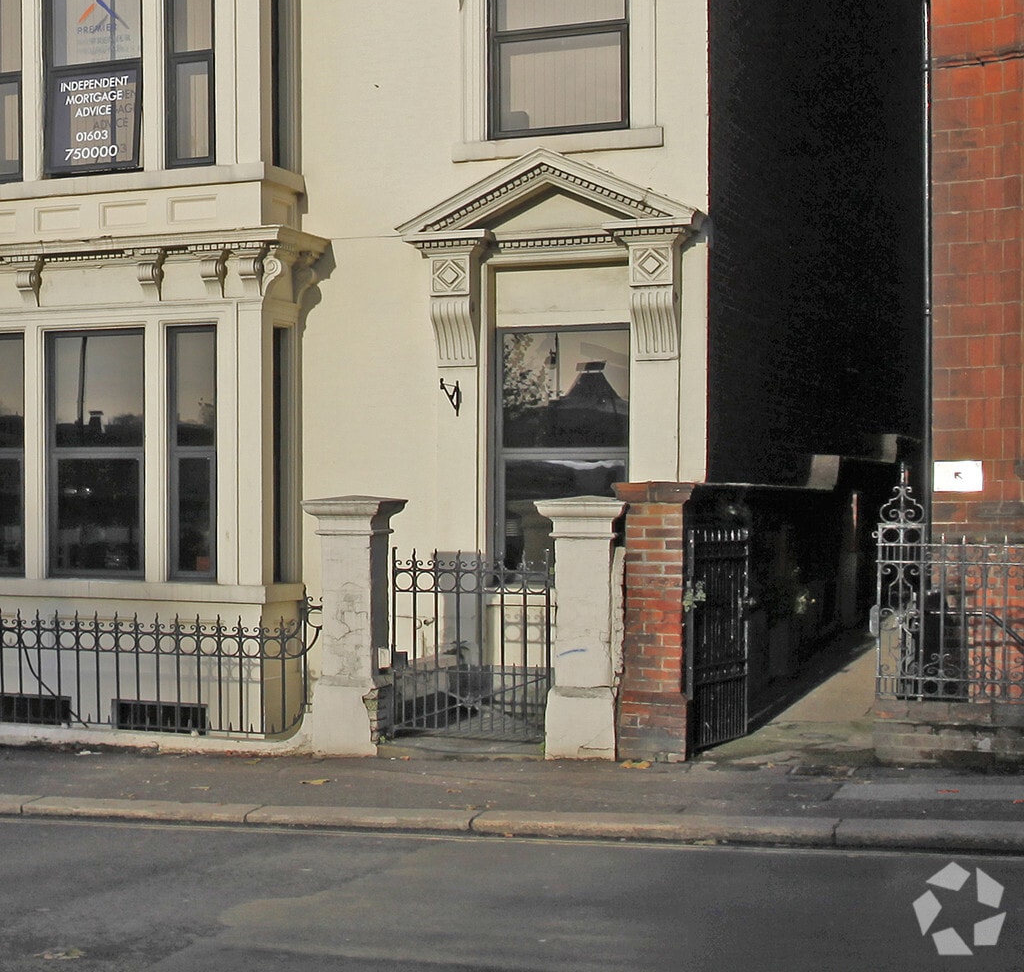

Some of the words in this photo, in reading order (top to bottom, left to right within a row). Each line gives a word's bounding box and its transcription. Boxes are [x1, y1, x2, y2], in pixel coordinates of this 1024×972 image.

[60, 76, 129, 92] INDEPENDENT
[65, 90, 123, 105] MORTGAGE
[75, 105, 112, 117] ADVICE
[76, 130, 108, 142] 01603
[65, 145, 118, 161] 750000
